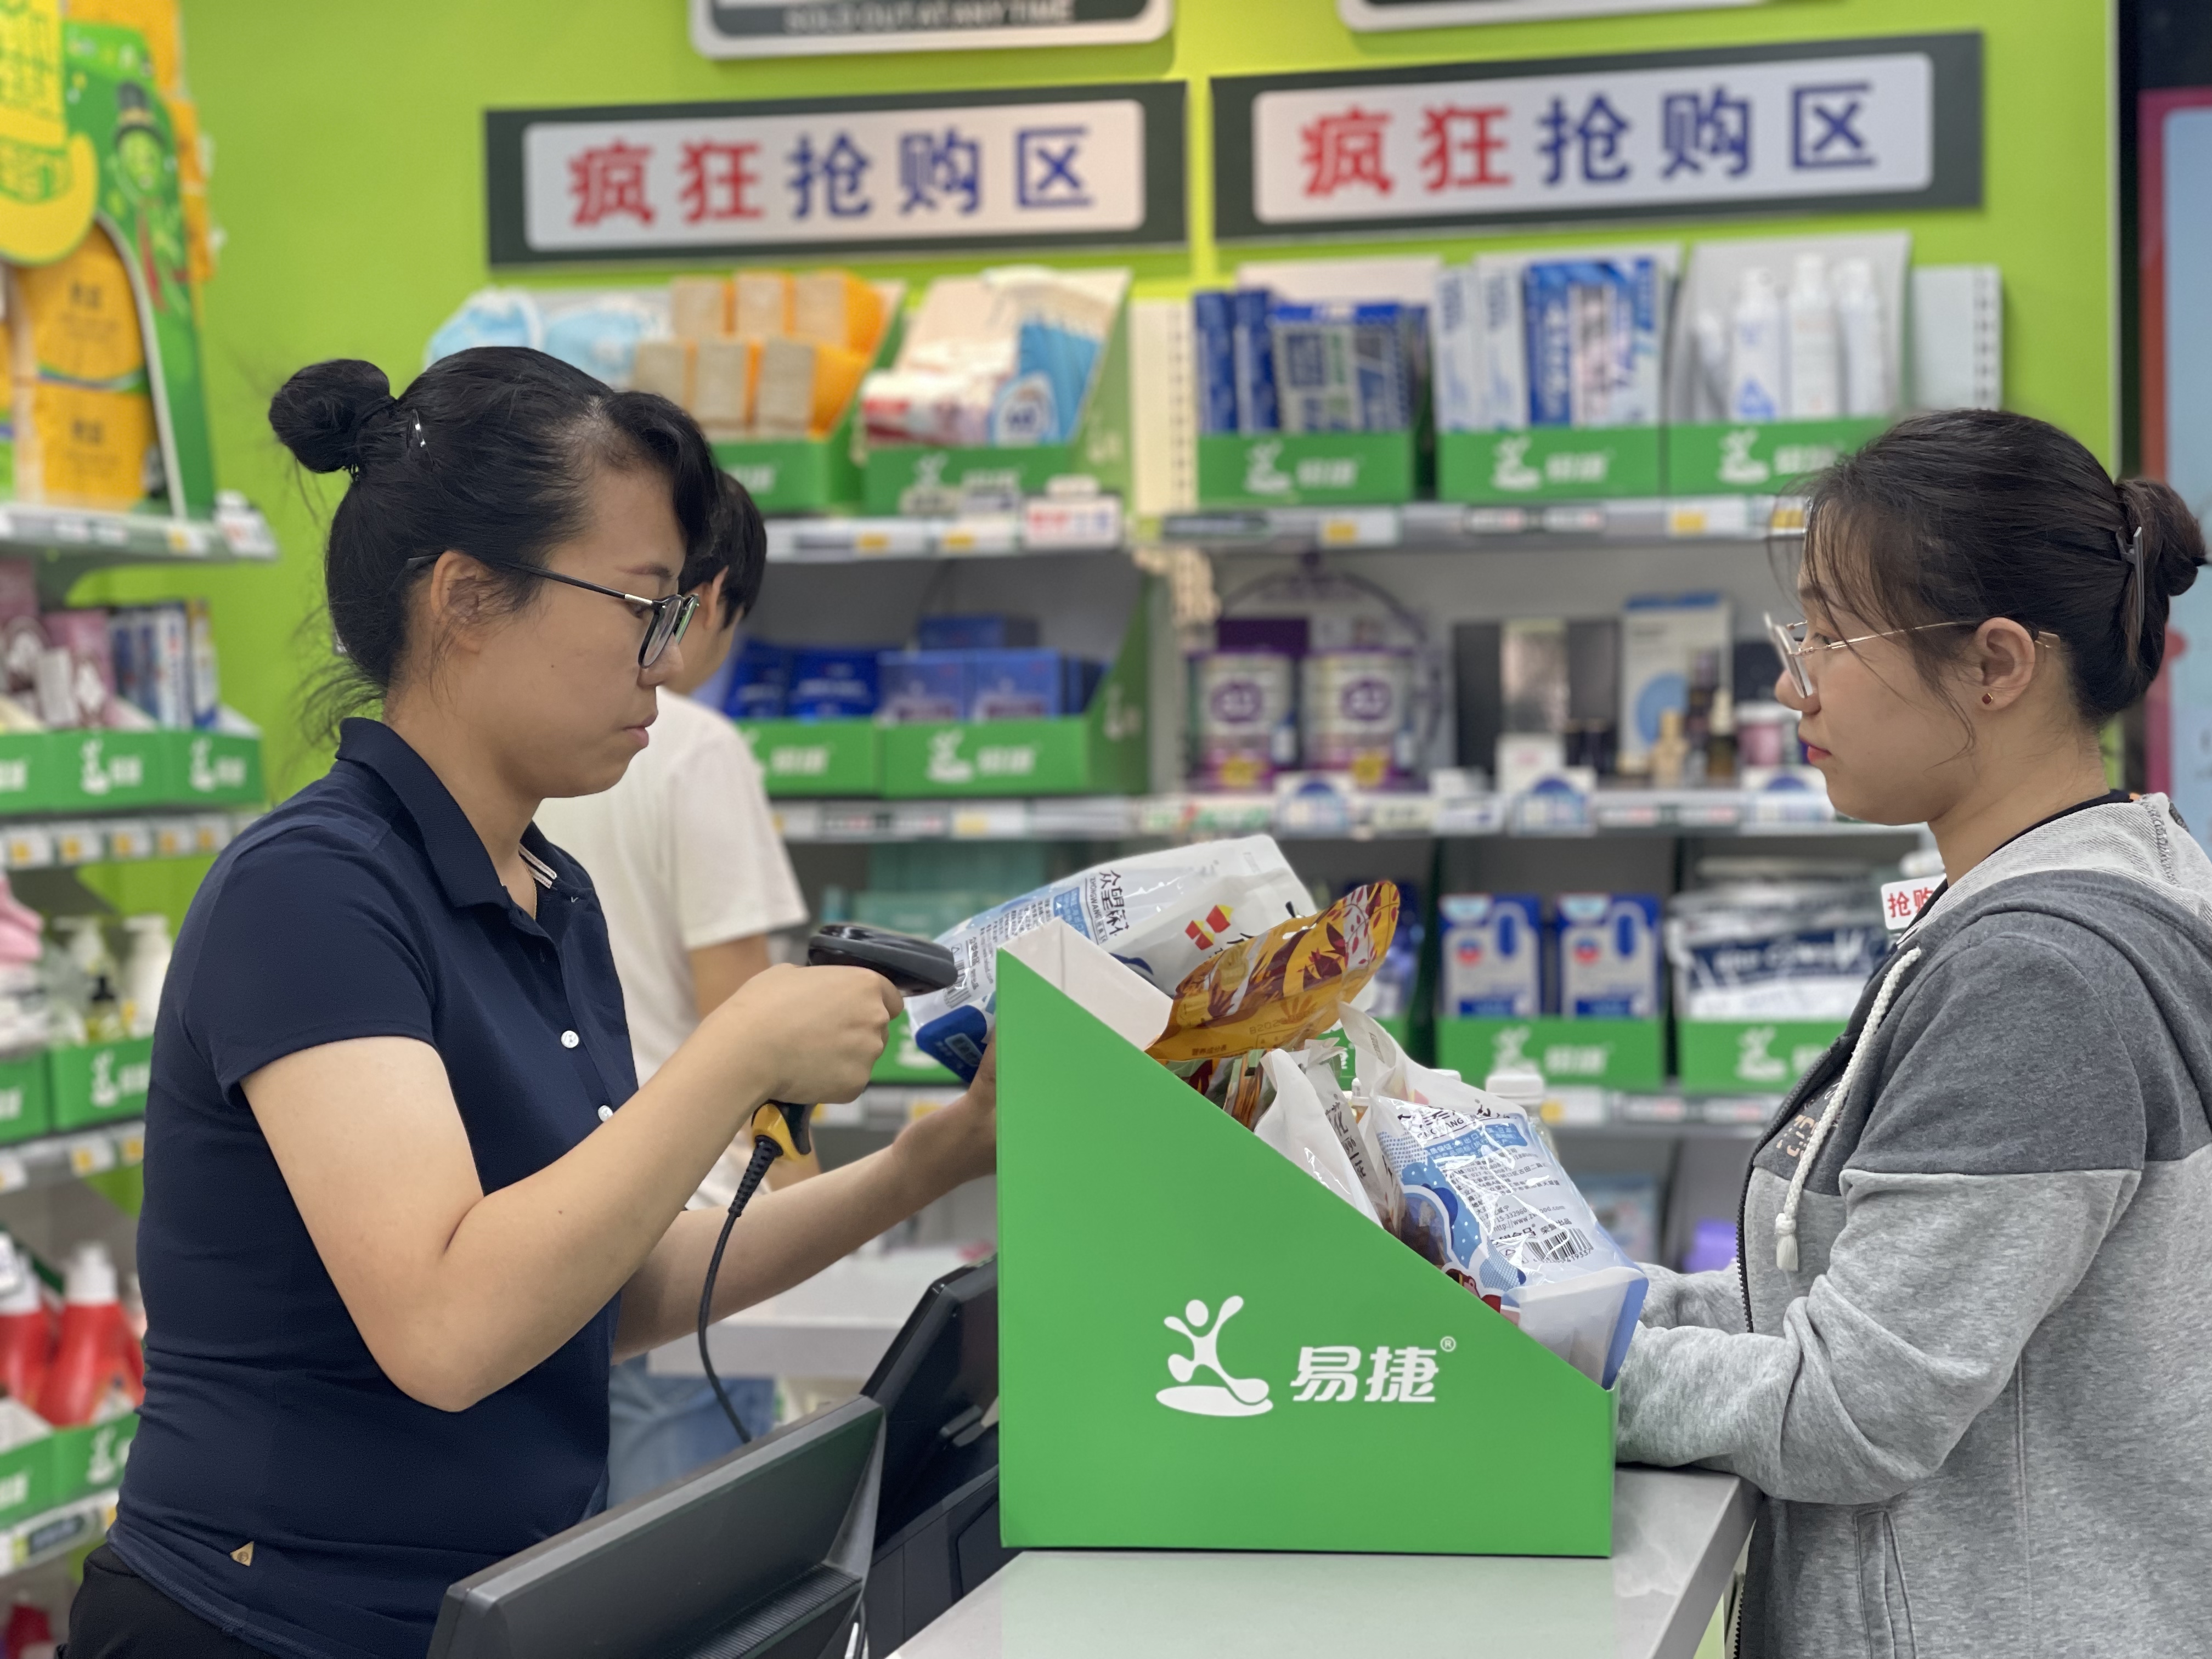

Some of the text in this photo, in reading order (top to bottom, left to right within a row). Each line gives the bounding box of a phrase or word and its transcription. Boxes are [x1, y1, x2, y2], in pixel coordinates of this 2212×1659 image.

[568, 124, 1094, 228] 疯狂抢购区
[1300, 82, 1875, 196] 疯狂抢购区
[1090, 876, 1102, 919] ZHONGWANG
[1290, 1345, 1439, 1402] 易捷
